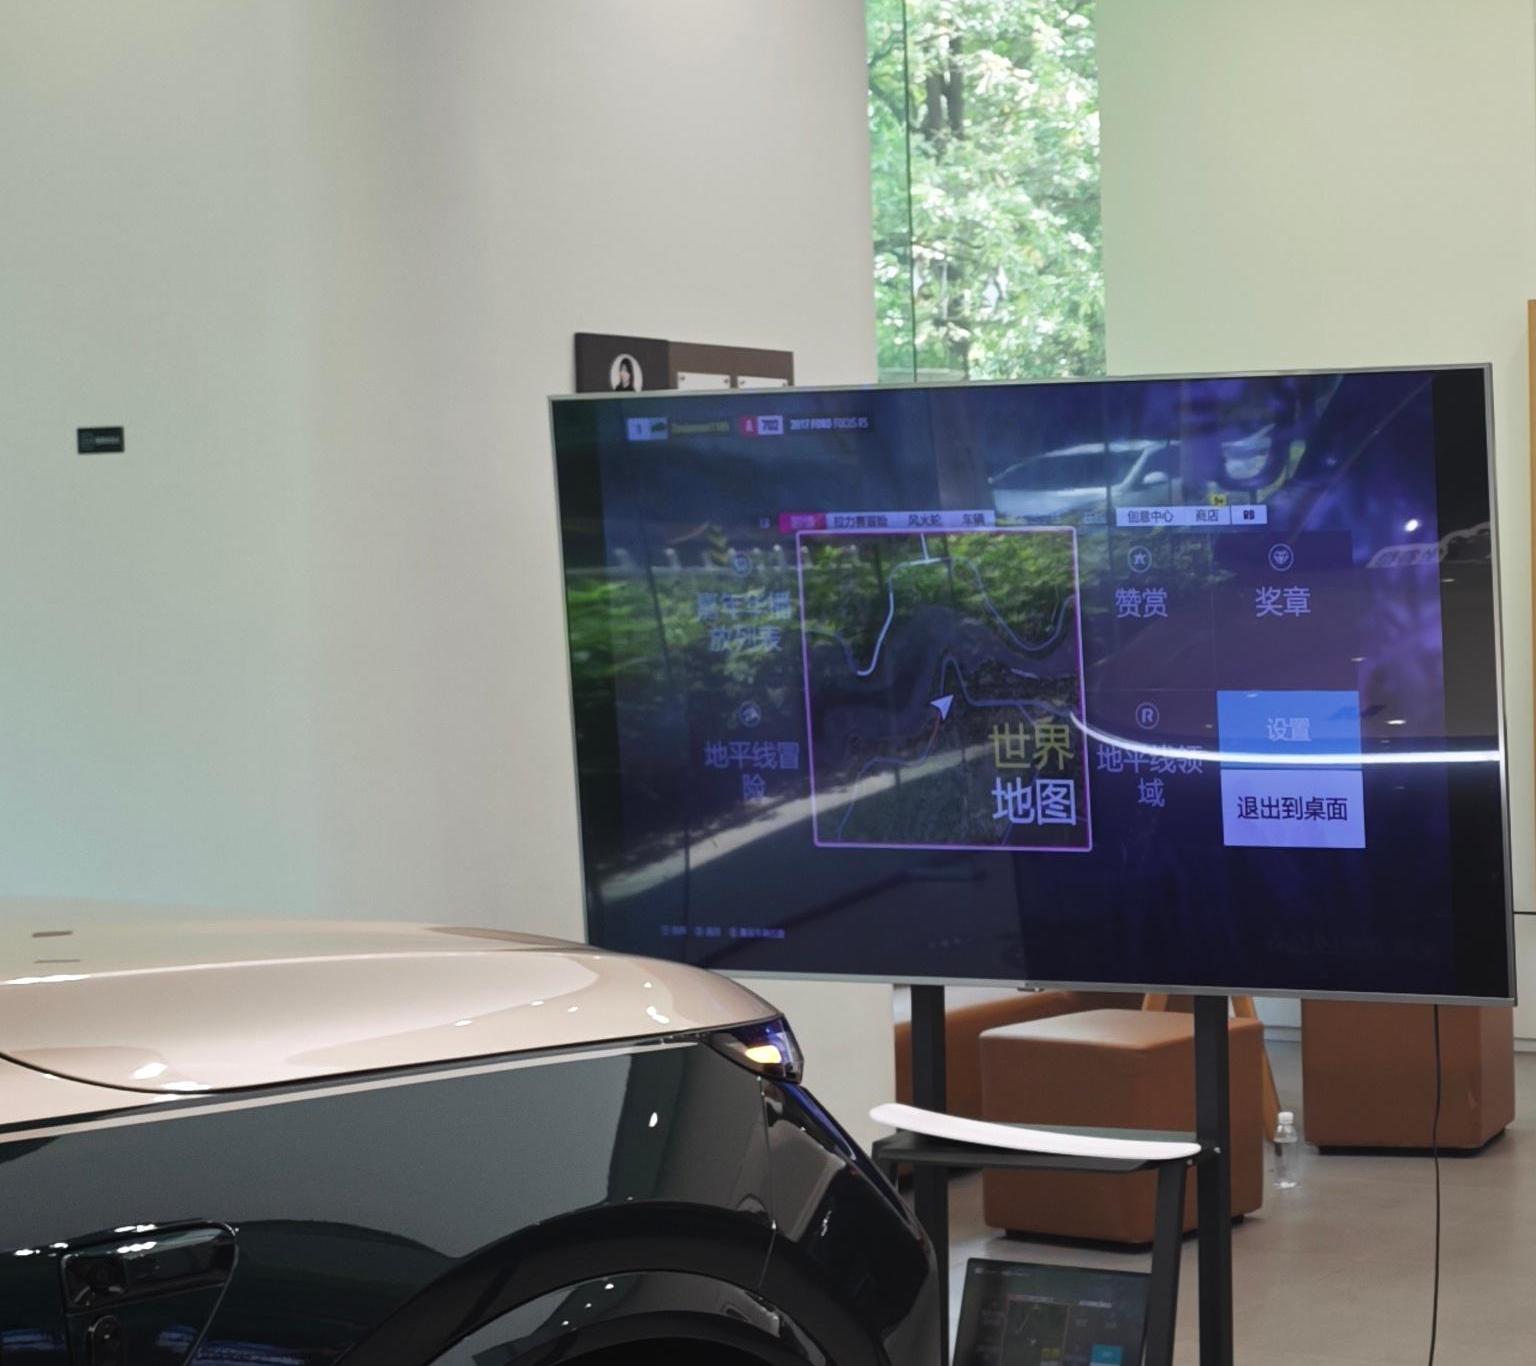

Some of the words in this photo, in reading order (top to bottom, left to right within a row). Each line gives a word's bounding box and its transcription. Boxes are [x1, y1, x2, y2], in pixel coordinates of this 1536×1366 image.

[1127, 509, 1175, 524] 创意中心
[1196, 508, 1219, 523] 商店
[1114, 587, 1169, 619] 赞赏
[1255, 585, 1312, 618] 奖章
[1266, 717, 1312, 743] 设置
[988, 721, 1075, 771] 世界
[991, 776, 1077, 826] 地图
[1137, 777, 1166, 808] 域
[1236, 795, 1349, 822] 退出到桌面
